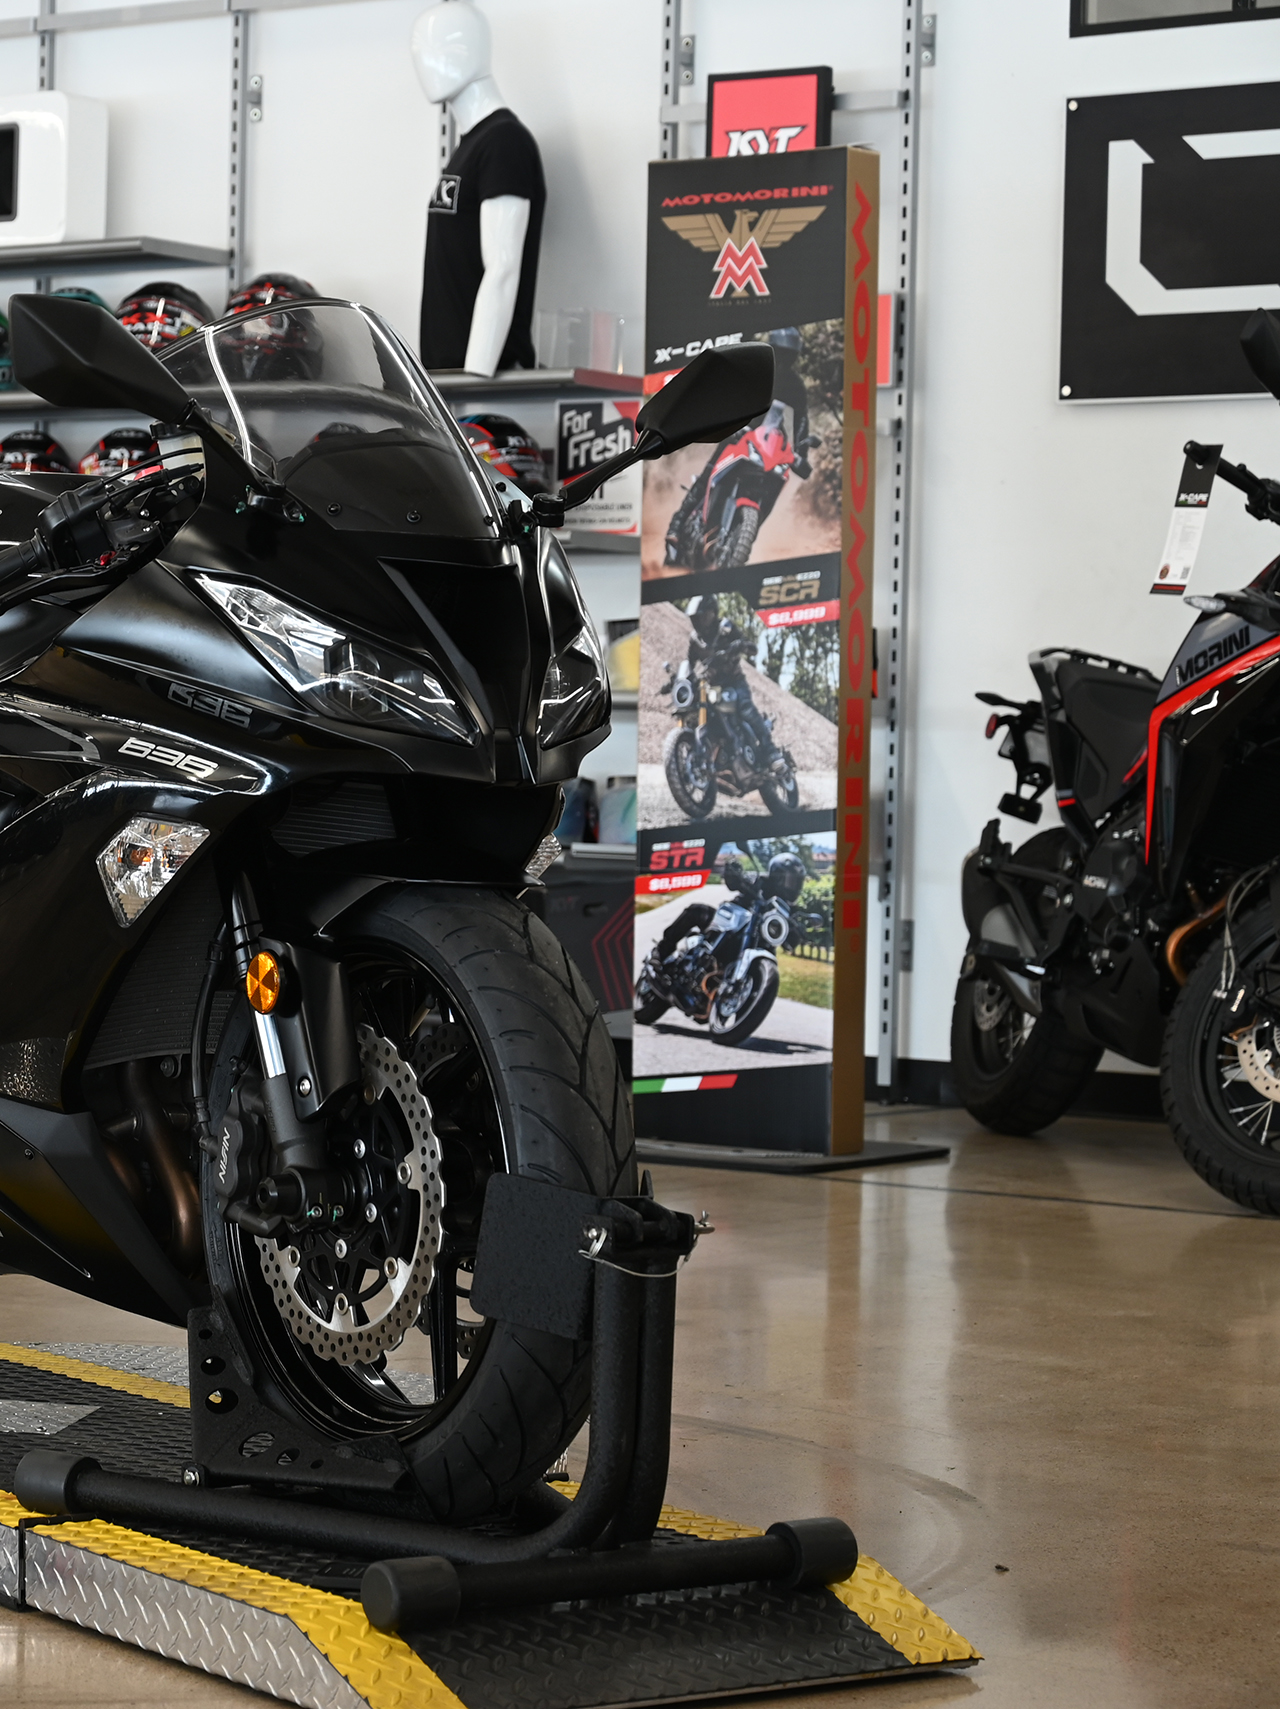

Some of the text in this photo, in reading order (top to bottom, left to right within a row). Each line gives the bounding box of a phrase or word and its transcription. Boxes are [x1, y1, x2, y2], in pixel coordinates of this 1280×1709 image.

[724, 124, 809, 157] KYT
[661, 185, 829, 207] MOTOMORINI
[562, 409, 592, 438] For
[568, 425, 632, 471] Fresh
[843, 182, 872, 929] MOTOMORINI
[1177, 625, 1251, 687] MORINI
[118, 736, 219, 779] 636
